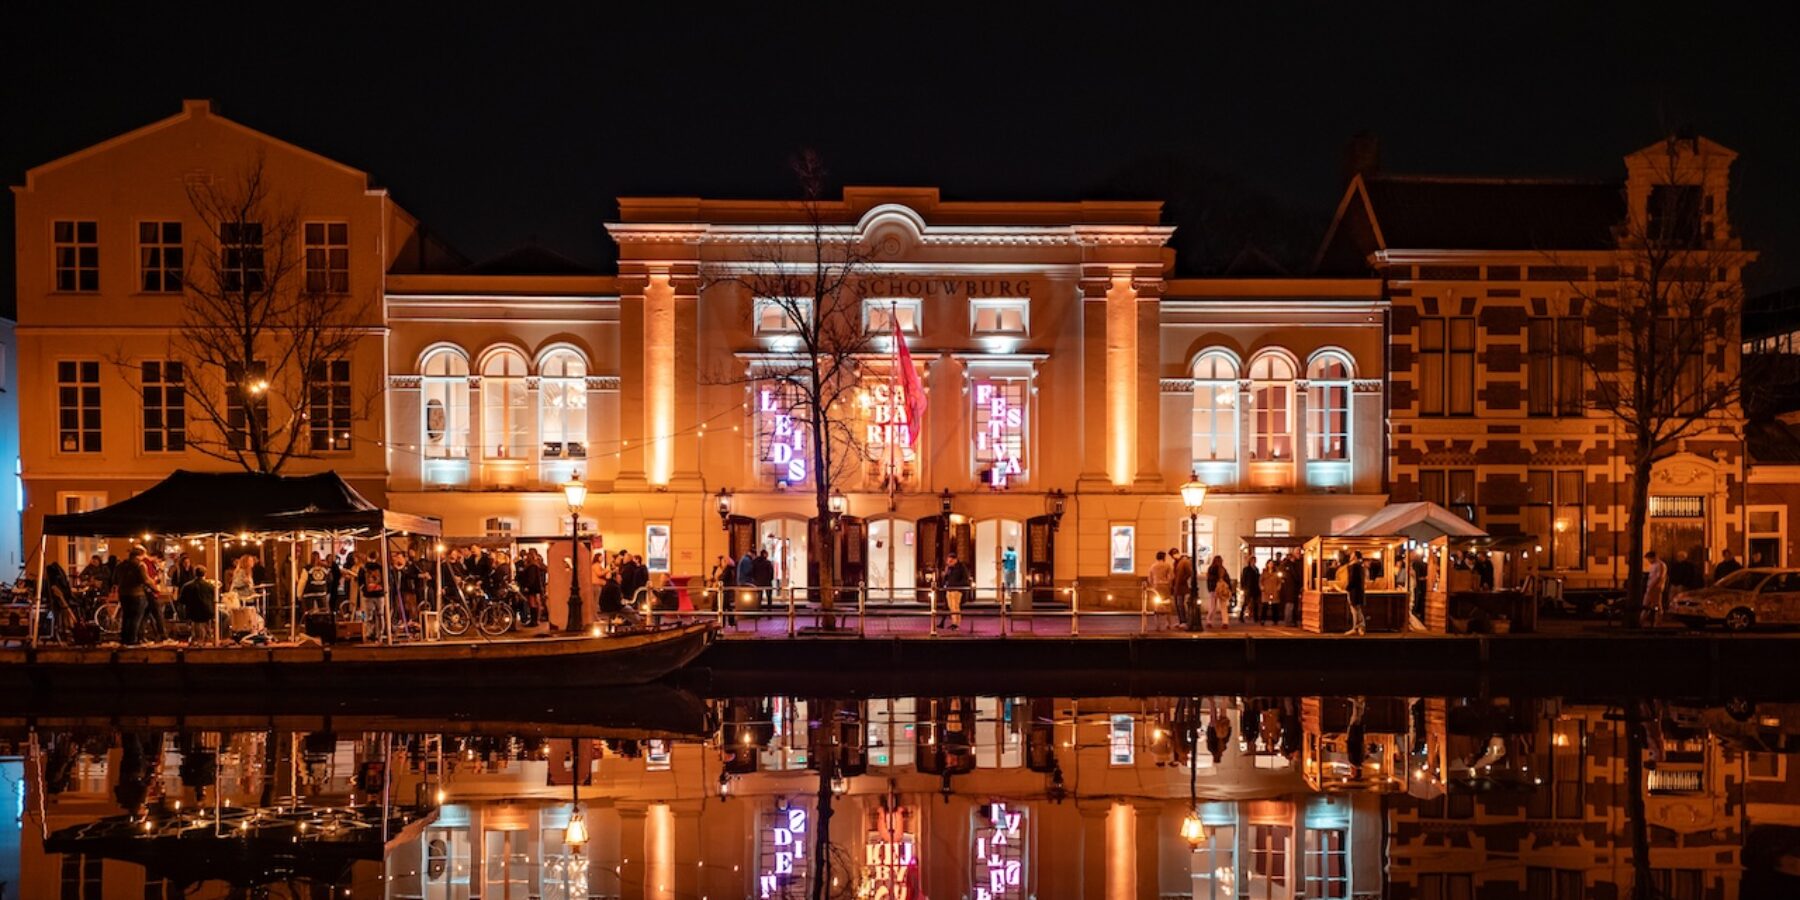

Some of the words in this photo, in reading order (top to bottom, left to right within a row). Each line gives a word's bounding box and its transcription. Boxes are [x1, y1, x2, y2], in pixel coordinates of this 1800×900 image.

[857, 279, 1031, 297] SCHOUWBURG
[761, 390, 806, 481] LEIDS
[977, 384, 1022, 486] FESTIVAL
